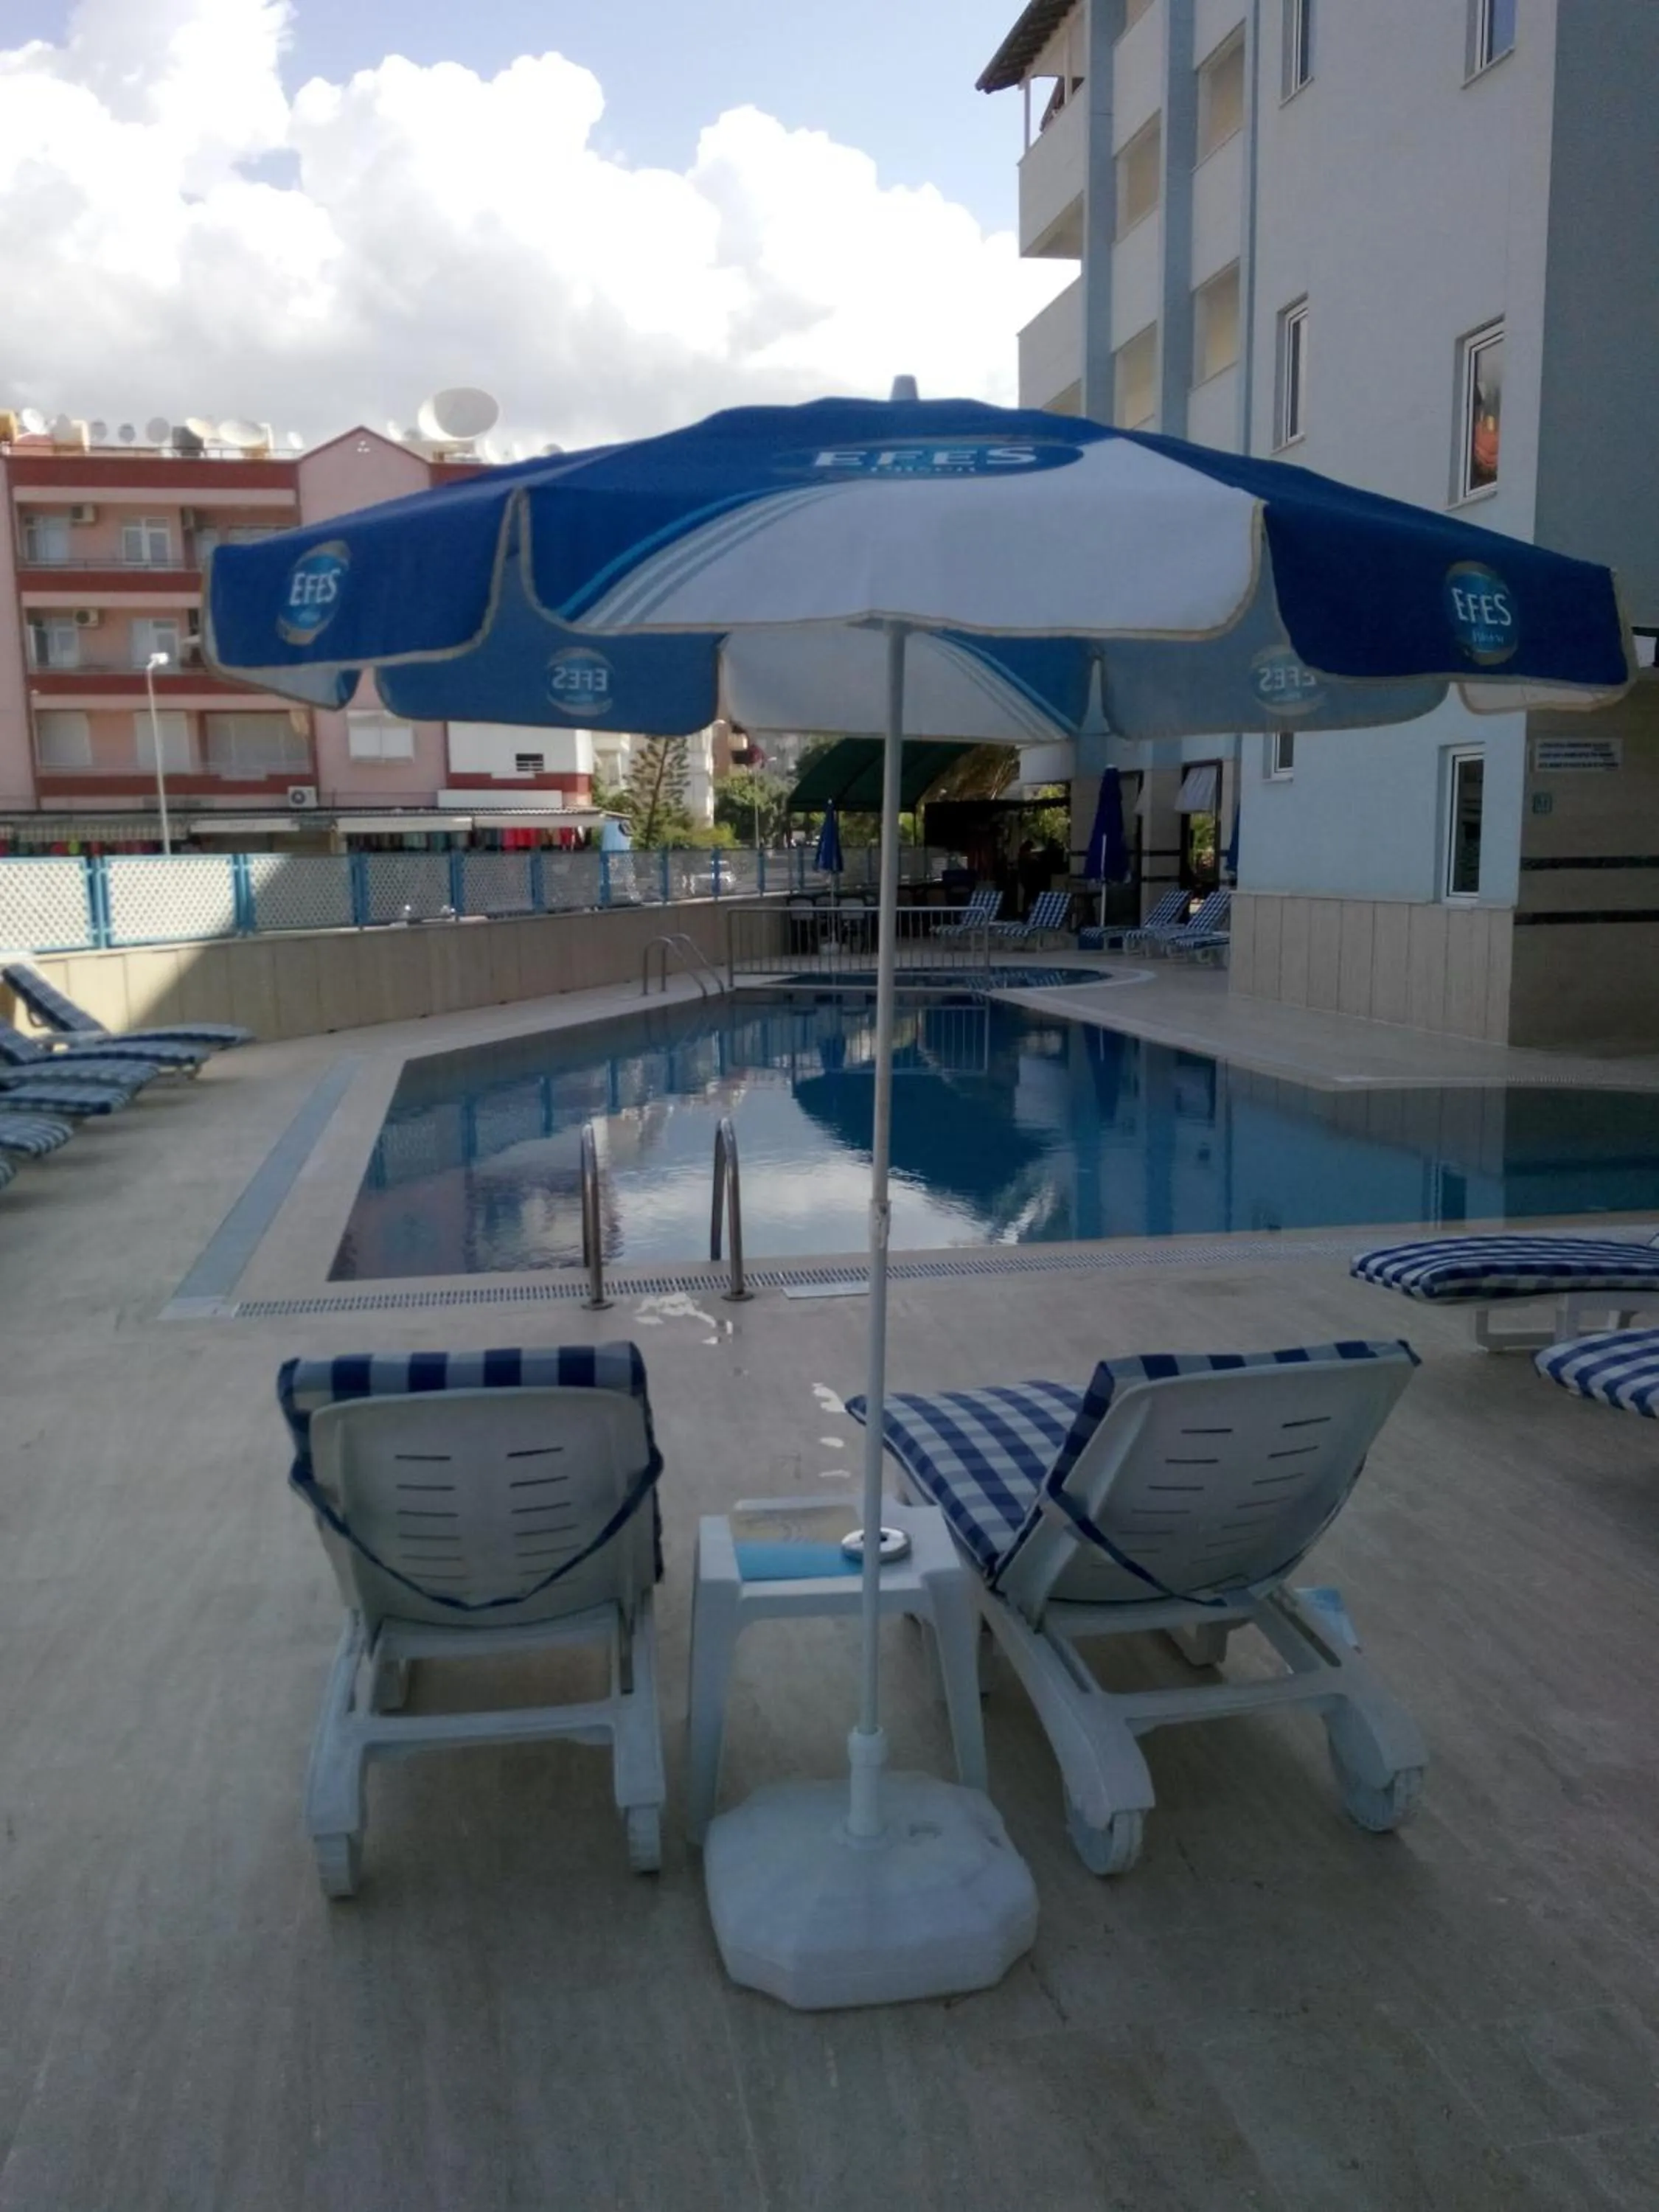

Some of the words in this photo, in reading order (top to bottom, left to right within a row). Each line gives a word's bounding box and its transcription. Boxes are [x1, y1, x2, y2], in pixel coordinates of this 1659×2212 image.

[815, 446, 1037, 466] EFES
[289, 568, 341, 606] EFES
[1451, 587, 1512, 626] EFES
